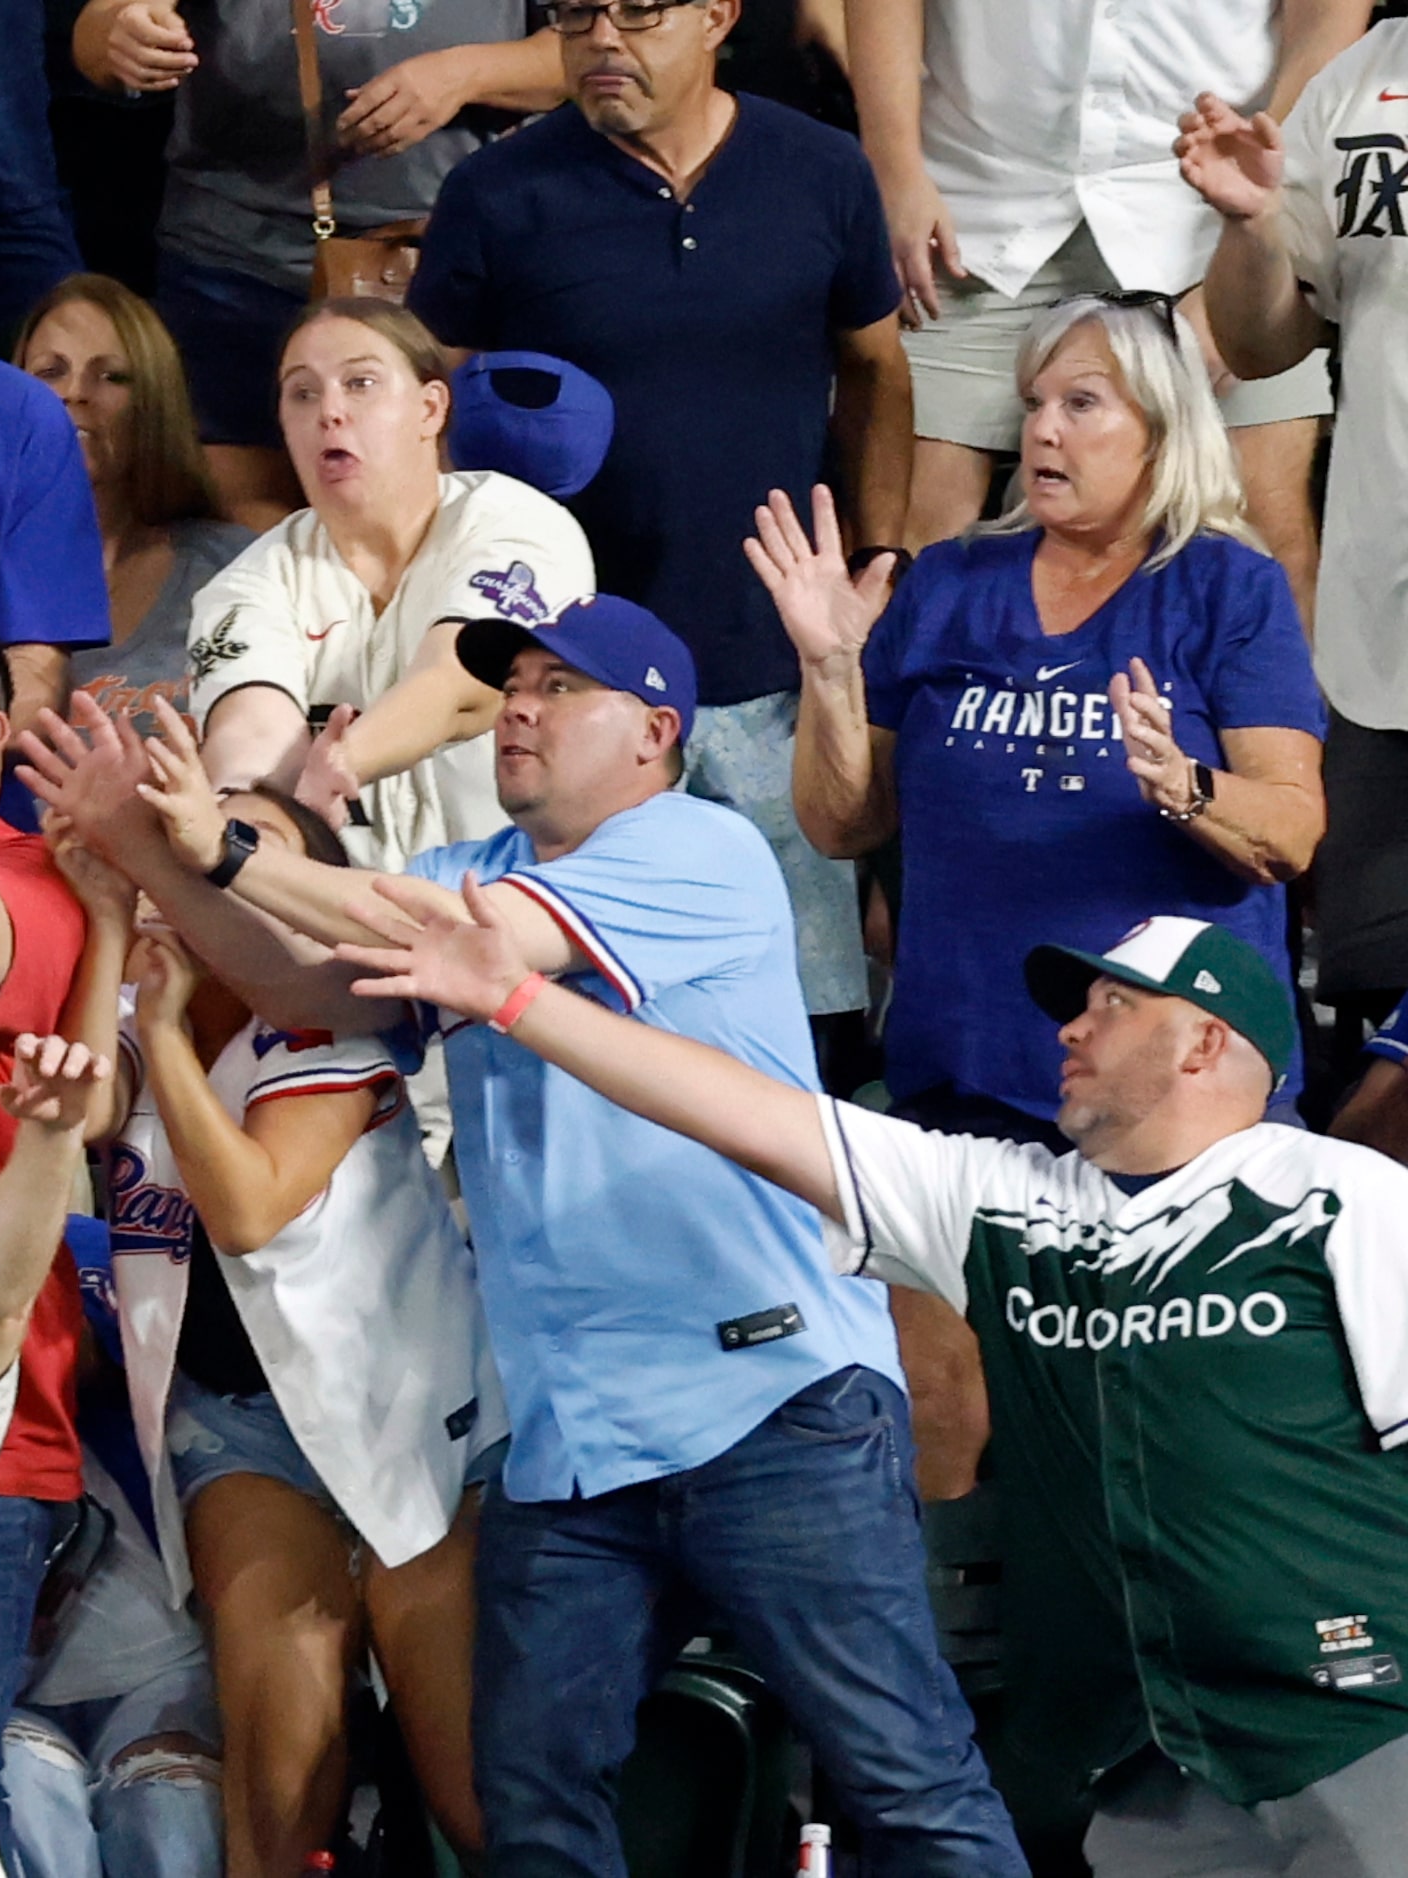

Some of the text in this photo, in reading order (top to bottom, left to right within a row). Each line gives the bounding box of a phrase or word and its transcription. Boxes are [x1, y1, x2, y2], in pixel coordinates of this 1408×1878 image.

[950, 682, 1174, 741] RANGE
[944, 735, 1110, 758] BASEBA
[1006, 1285, 1288, 1351] COLORADO
